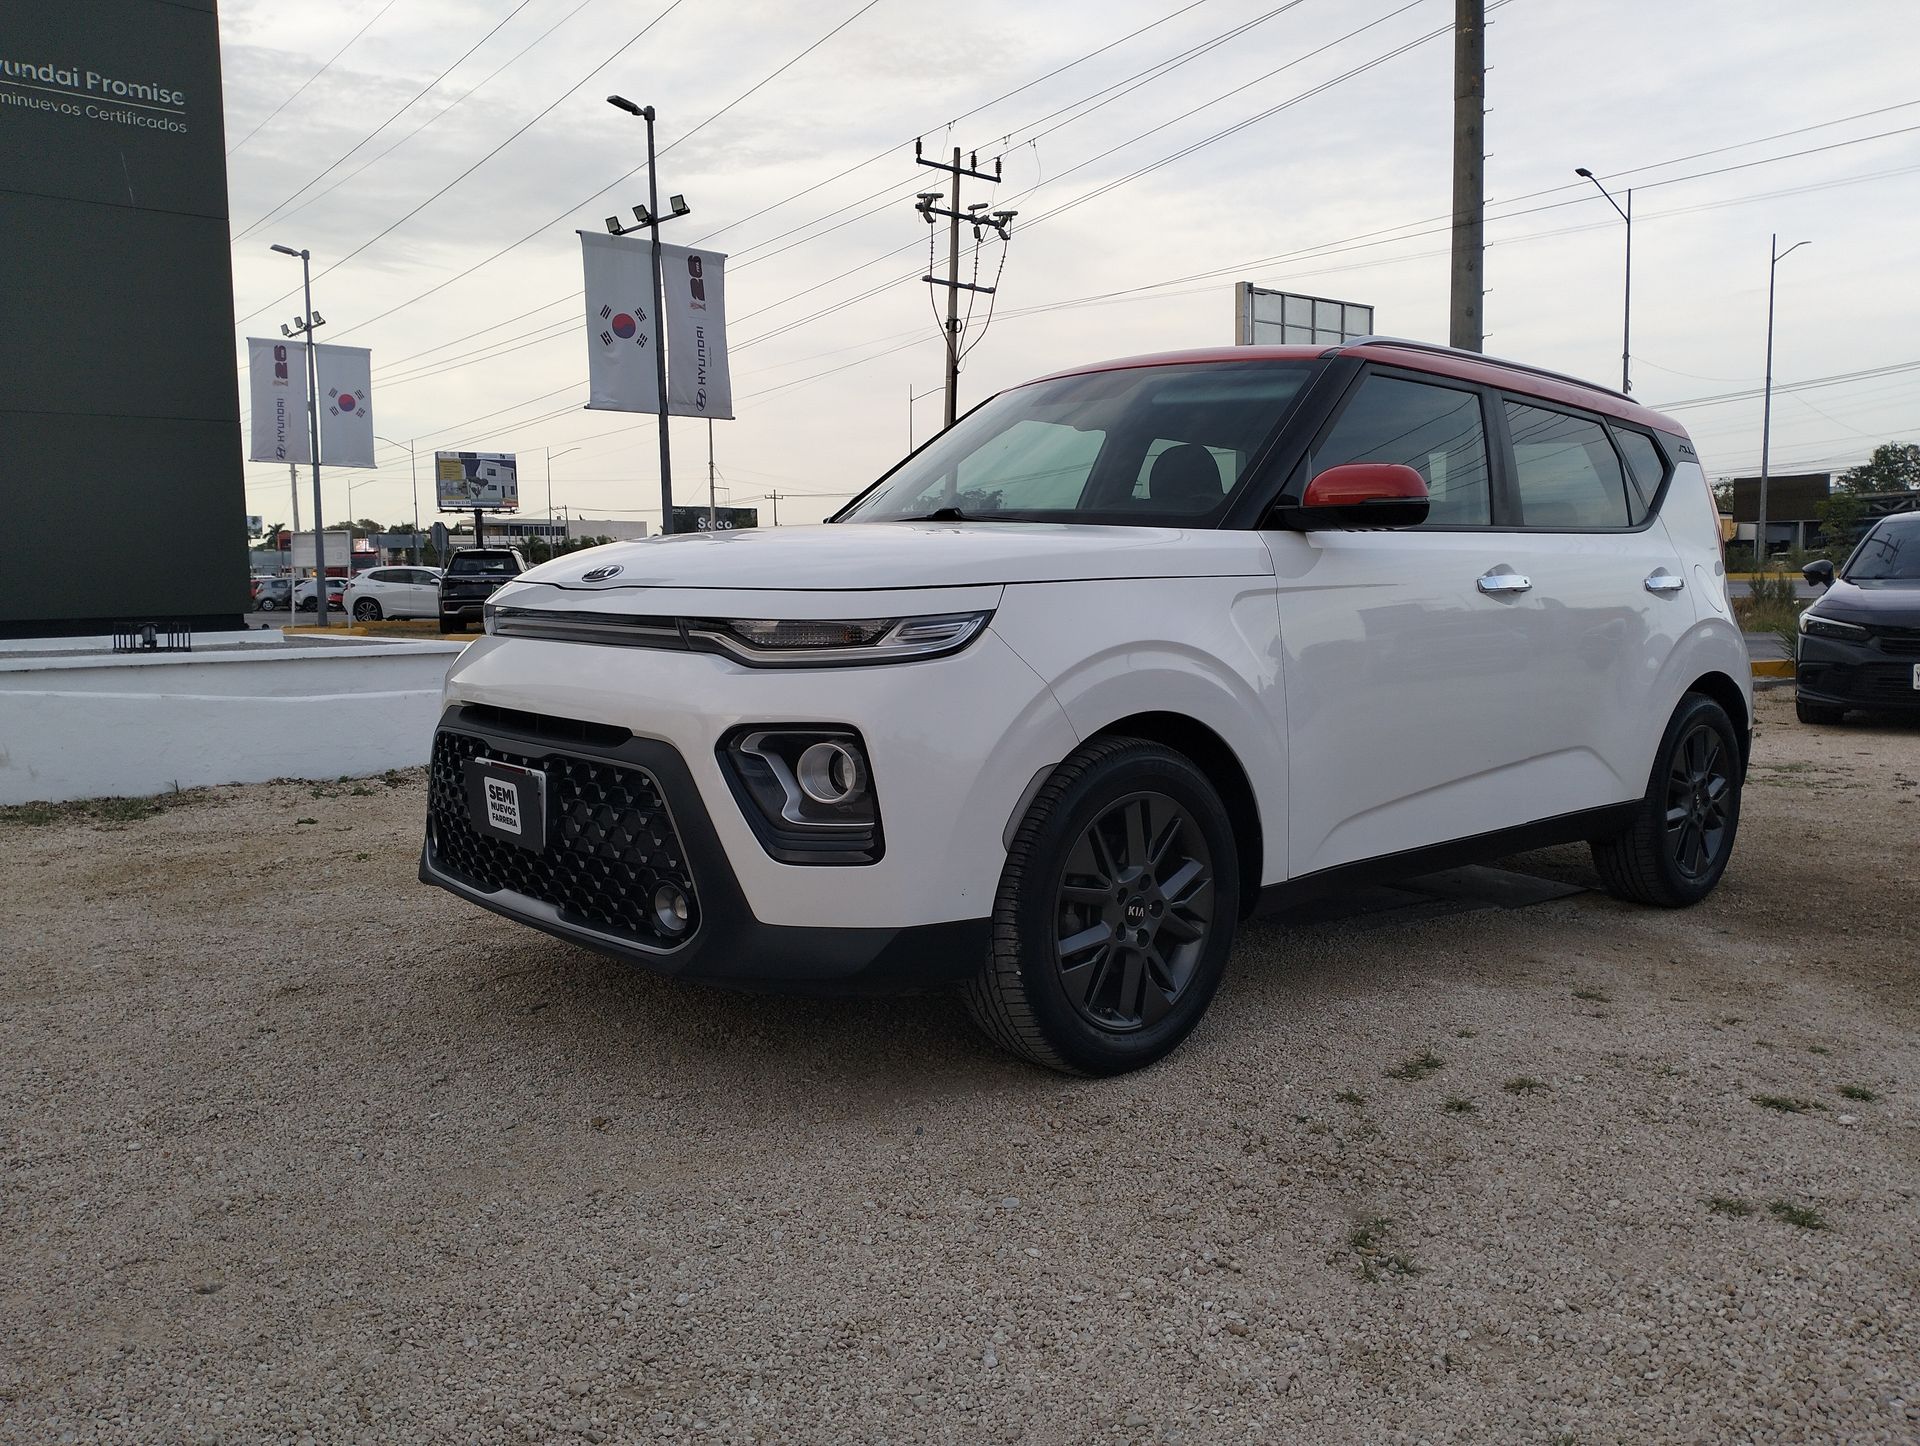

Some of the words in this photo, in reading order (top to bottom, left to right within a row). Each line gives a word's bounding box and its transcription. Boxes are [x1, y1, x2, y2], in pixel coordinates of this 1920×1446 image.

[0, 60, 79, 87] undai
[87, 71, 186, 106] Promise
[86, 105, 188, 133] Certificados
[696, 326, 706, 385] HYUNDAI
[277, 398, 285, 443] HYUNDAI
[488, 784, 516, 806] SEMI
[490, 801, 517, 817] NUEVOS
[492, 812, 518, 828] FARRERA
[1128, 905, 1144, 917] KIA
